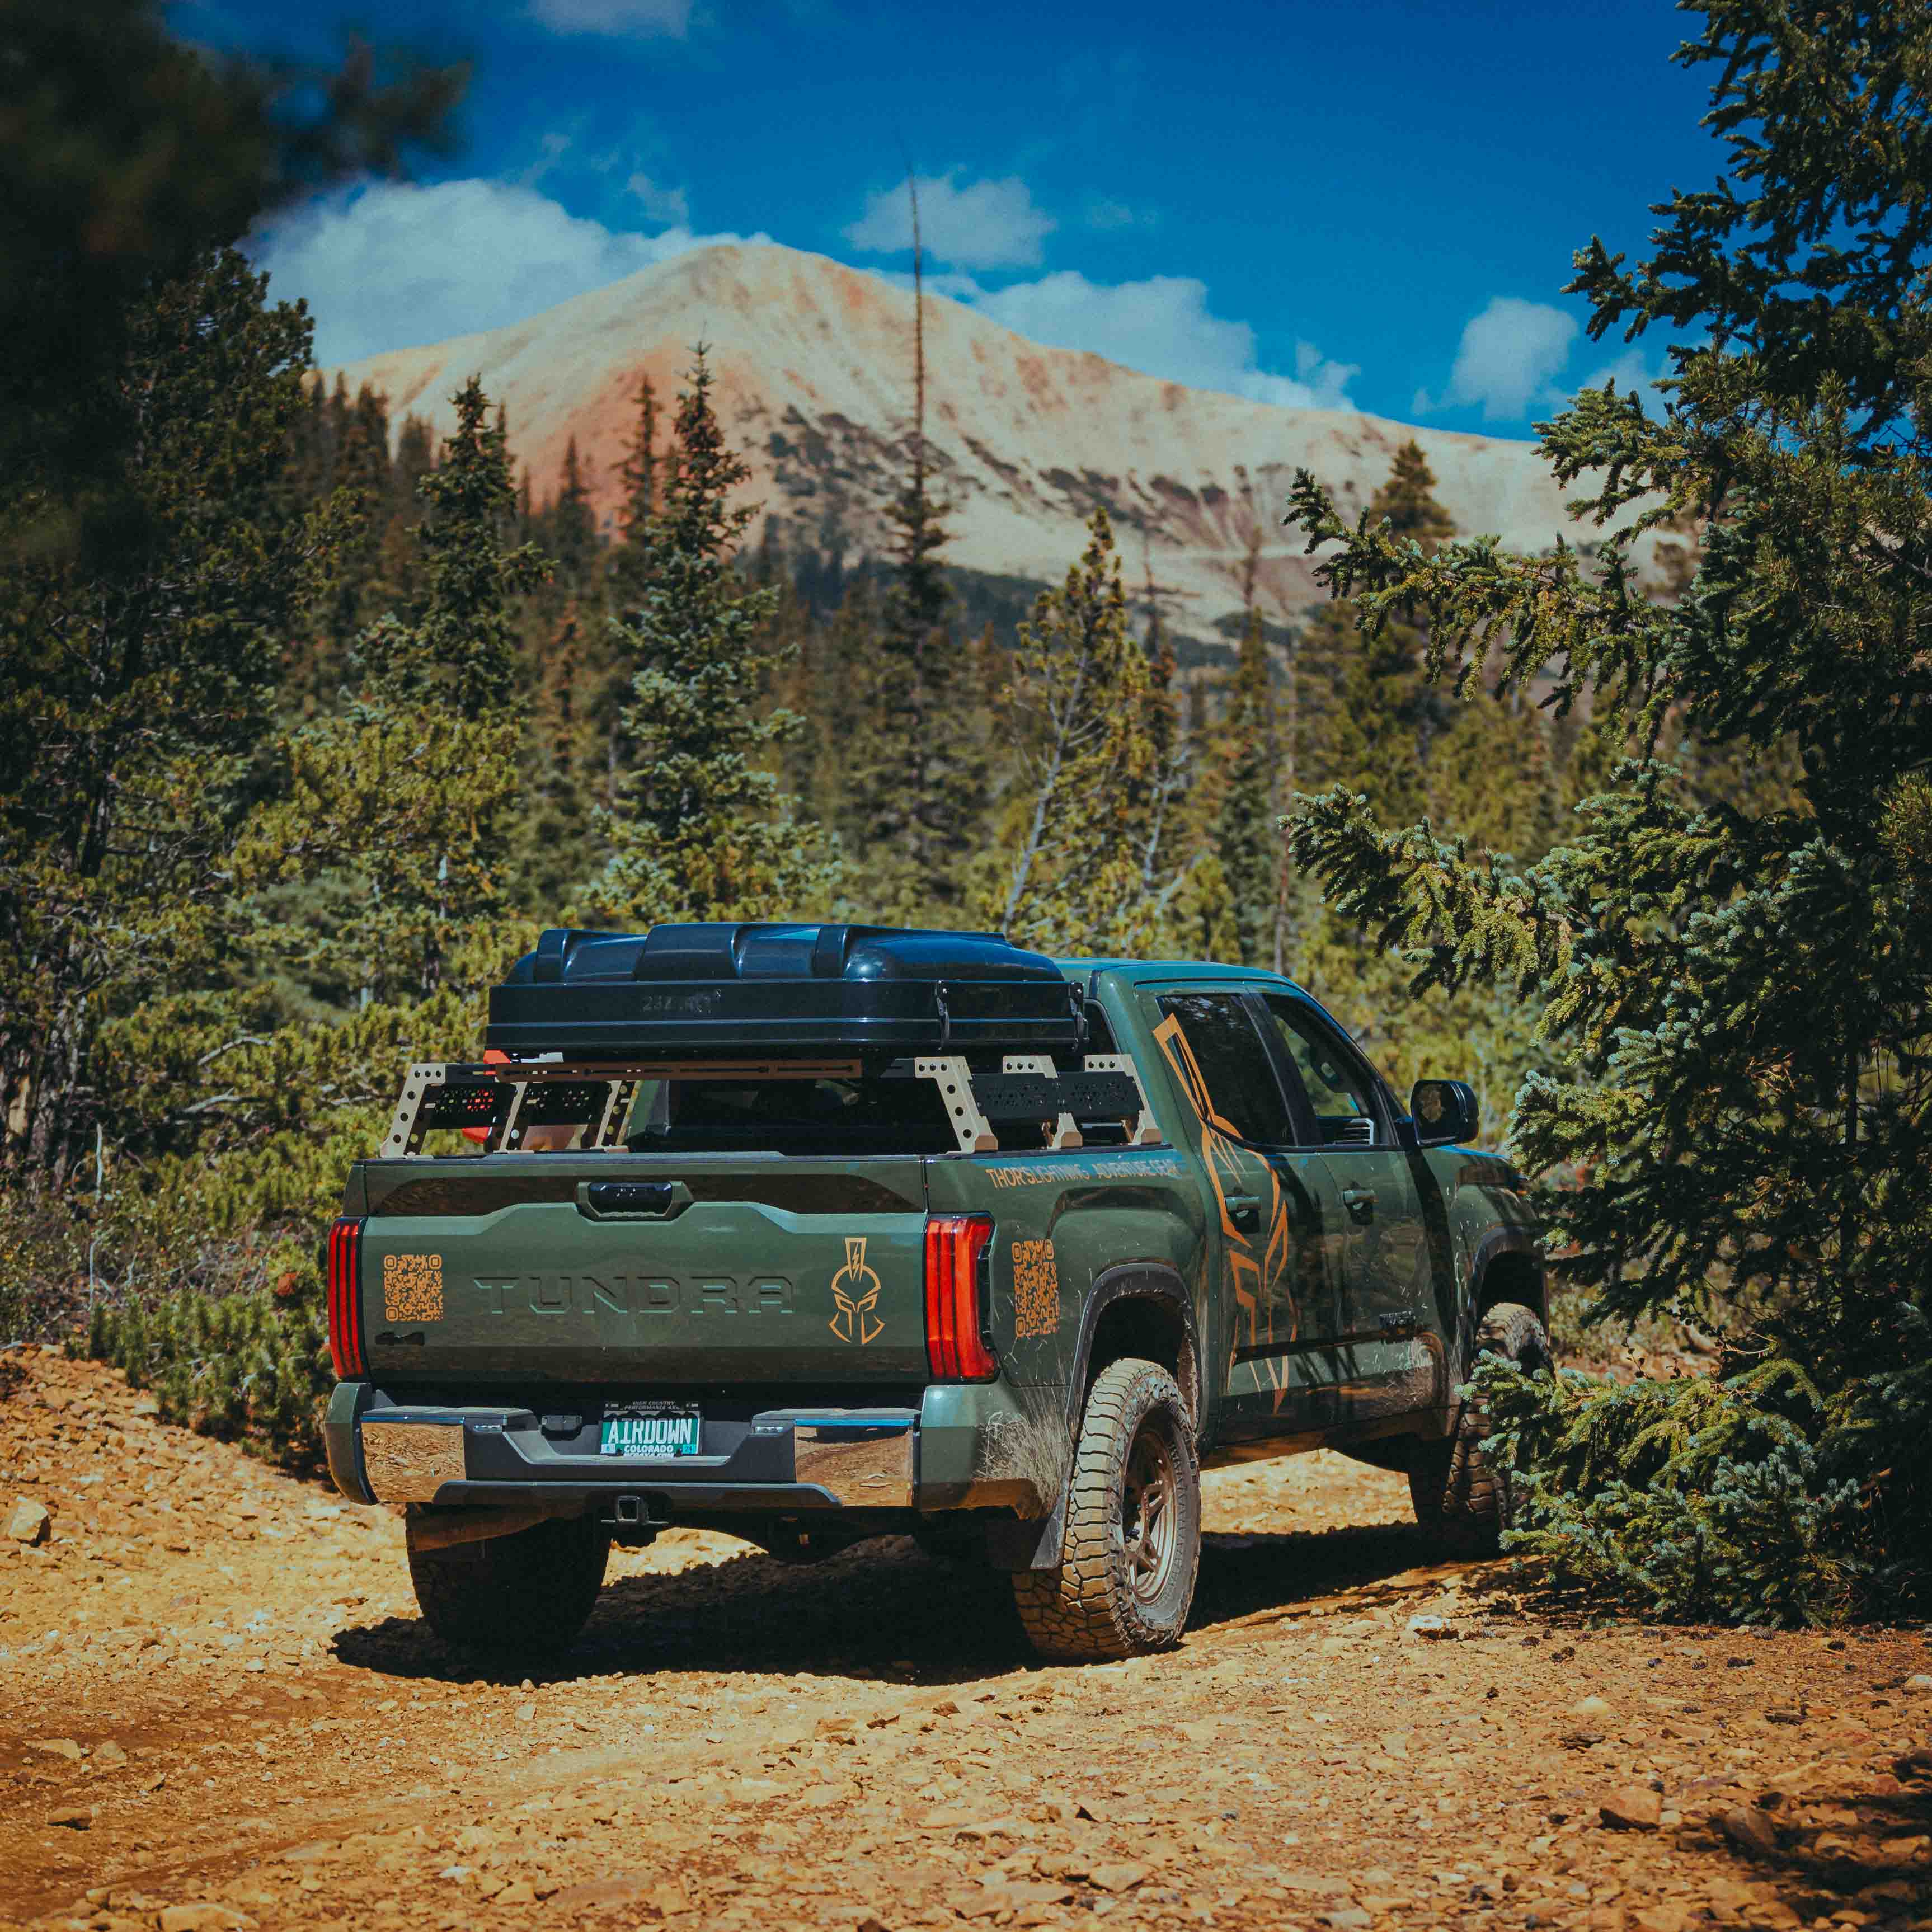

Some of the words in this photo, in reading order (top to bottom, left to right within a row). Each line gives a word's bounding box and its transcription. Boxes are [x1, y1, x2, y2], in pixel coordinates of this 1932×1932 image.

[474, 1277, 793, 1314] TUNDRA
[608, 1418, 692, 1444] AIRDOWN
[624, 1445, 674, 1453] COLORADO
